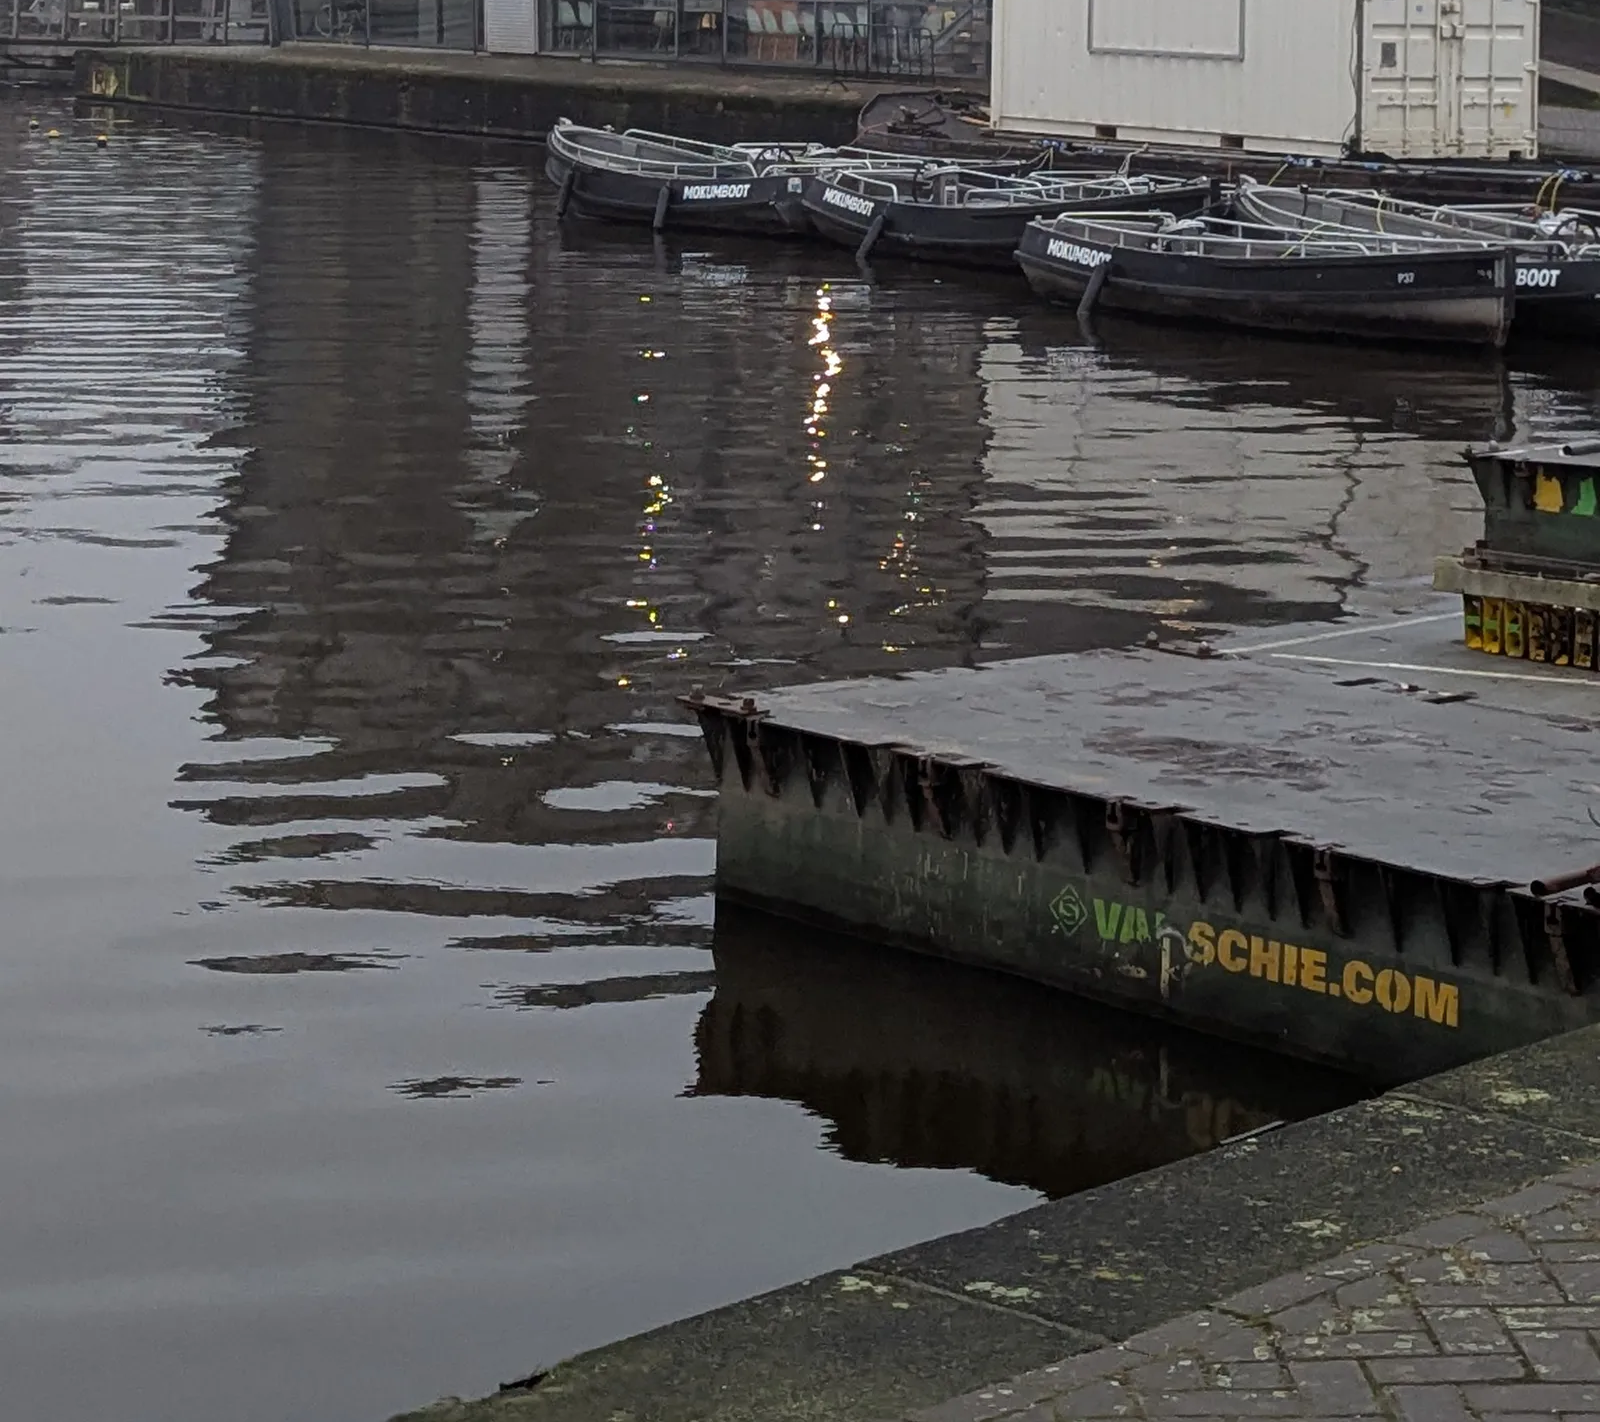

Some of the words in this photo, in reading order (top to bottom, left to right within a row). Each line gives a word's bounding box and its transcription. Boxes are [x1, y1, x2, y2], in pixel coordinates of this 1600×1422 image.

[683, 184, 751, 200] MOKUMBOOT
[822, 187, 875, 217] MOKUMBOOT
[1515, 268, 1561, 287] BOOT
[1187, 921, 1459, 1028] SCHIE.COM
